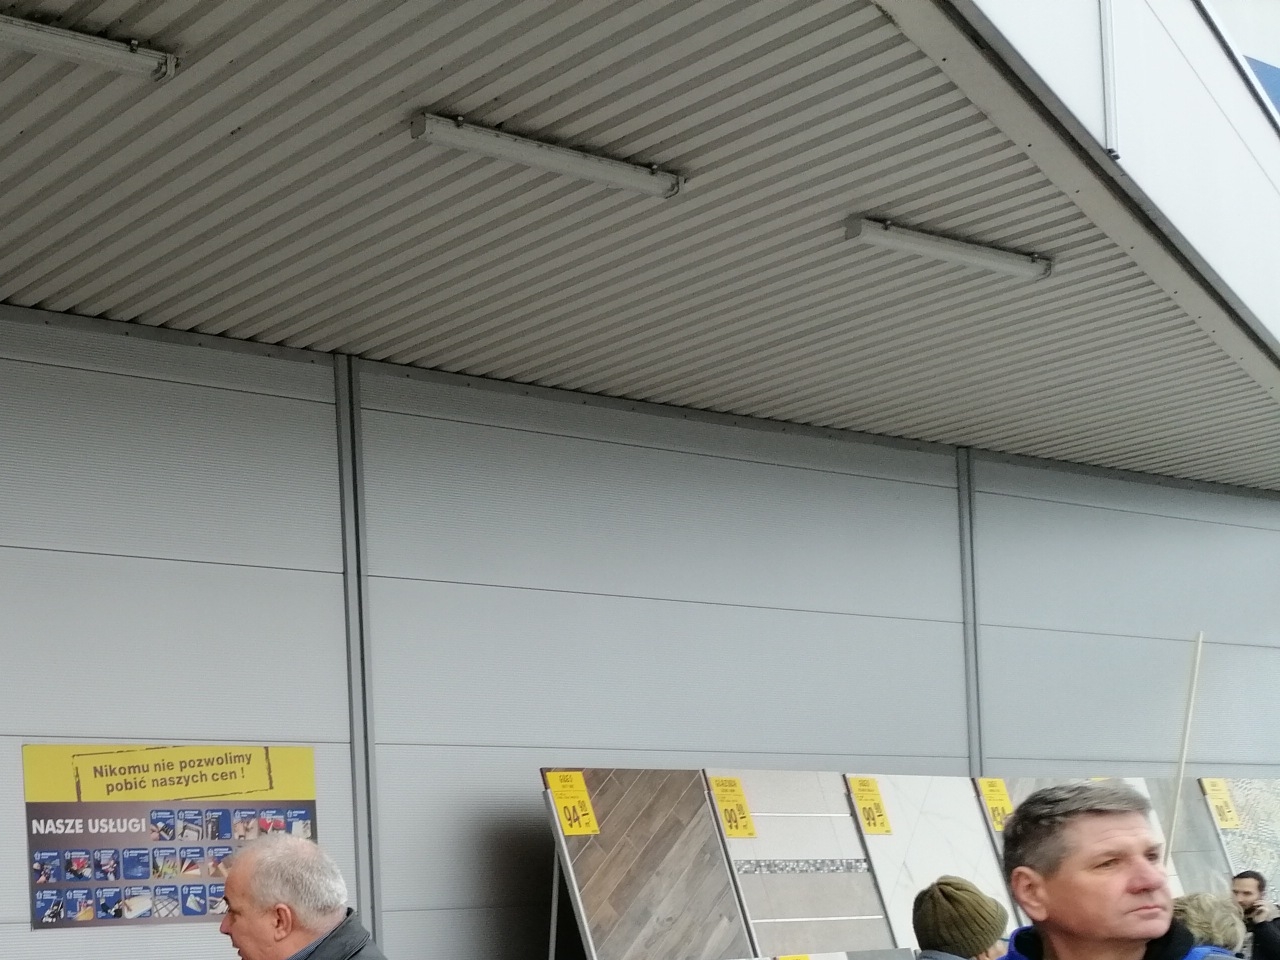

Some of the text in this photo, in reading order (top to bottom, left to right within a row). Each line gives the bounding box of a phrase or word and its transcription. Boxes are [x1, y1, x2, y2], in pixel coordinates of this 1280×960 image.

[93, 752, 253, 779] Nikomu nie pozwolimy
[106, 776, 147, 796] pobić
[151, 770, 209, 788] naszych
[211, 769, 238, 782] cen
[31, 817, 147, 835] NASZE USŁUGI
